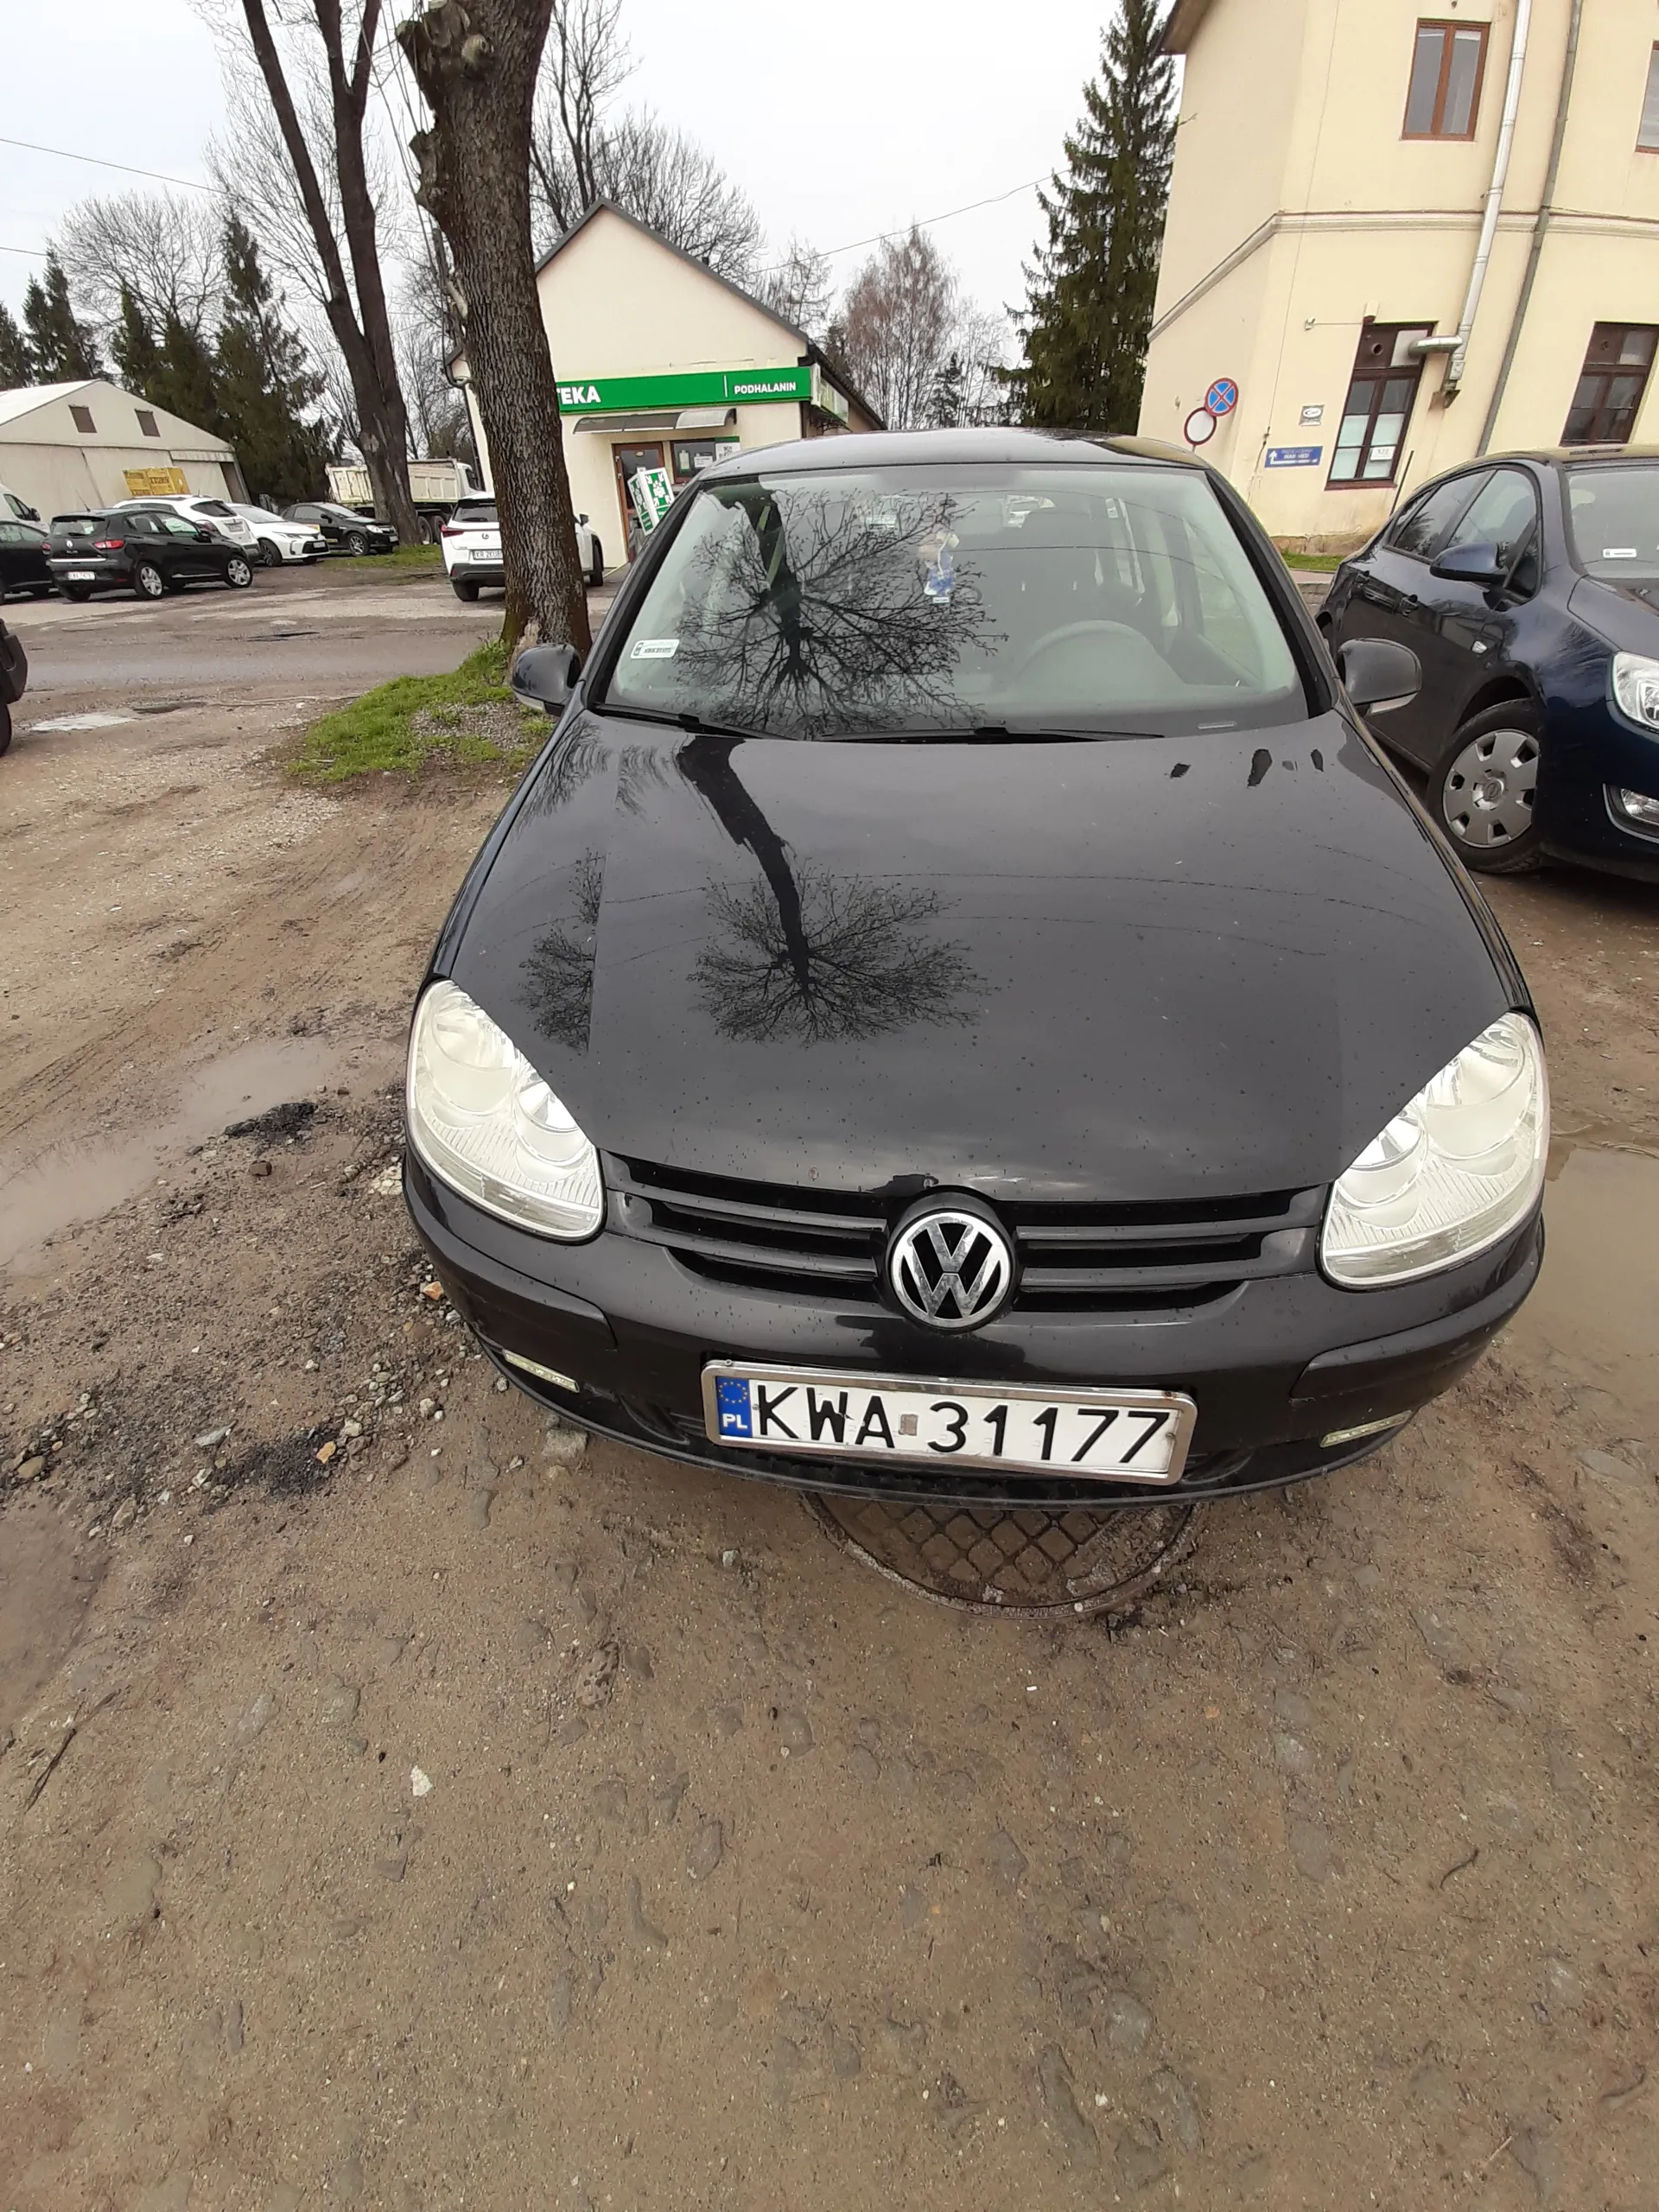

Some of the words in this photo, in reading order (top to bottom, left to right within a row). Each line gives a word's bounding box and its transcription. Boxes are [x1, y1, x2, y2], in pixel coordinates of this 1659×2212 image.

[734, 381, 797, 395] PODHALANIN
[722, 1413, 748, 1429] PL
[756, 1384, 895, 1448] KWA
[926, 1401, 1171, 1464] 31177
